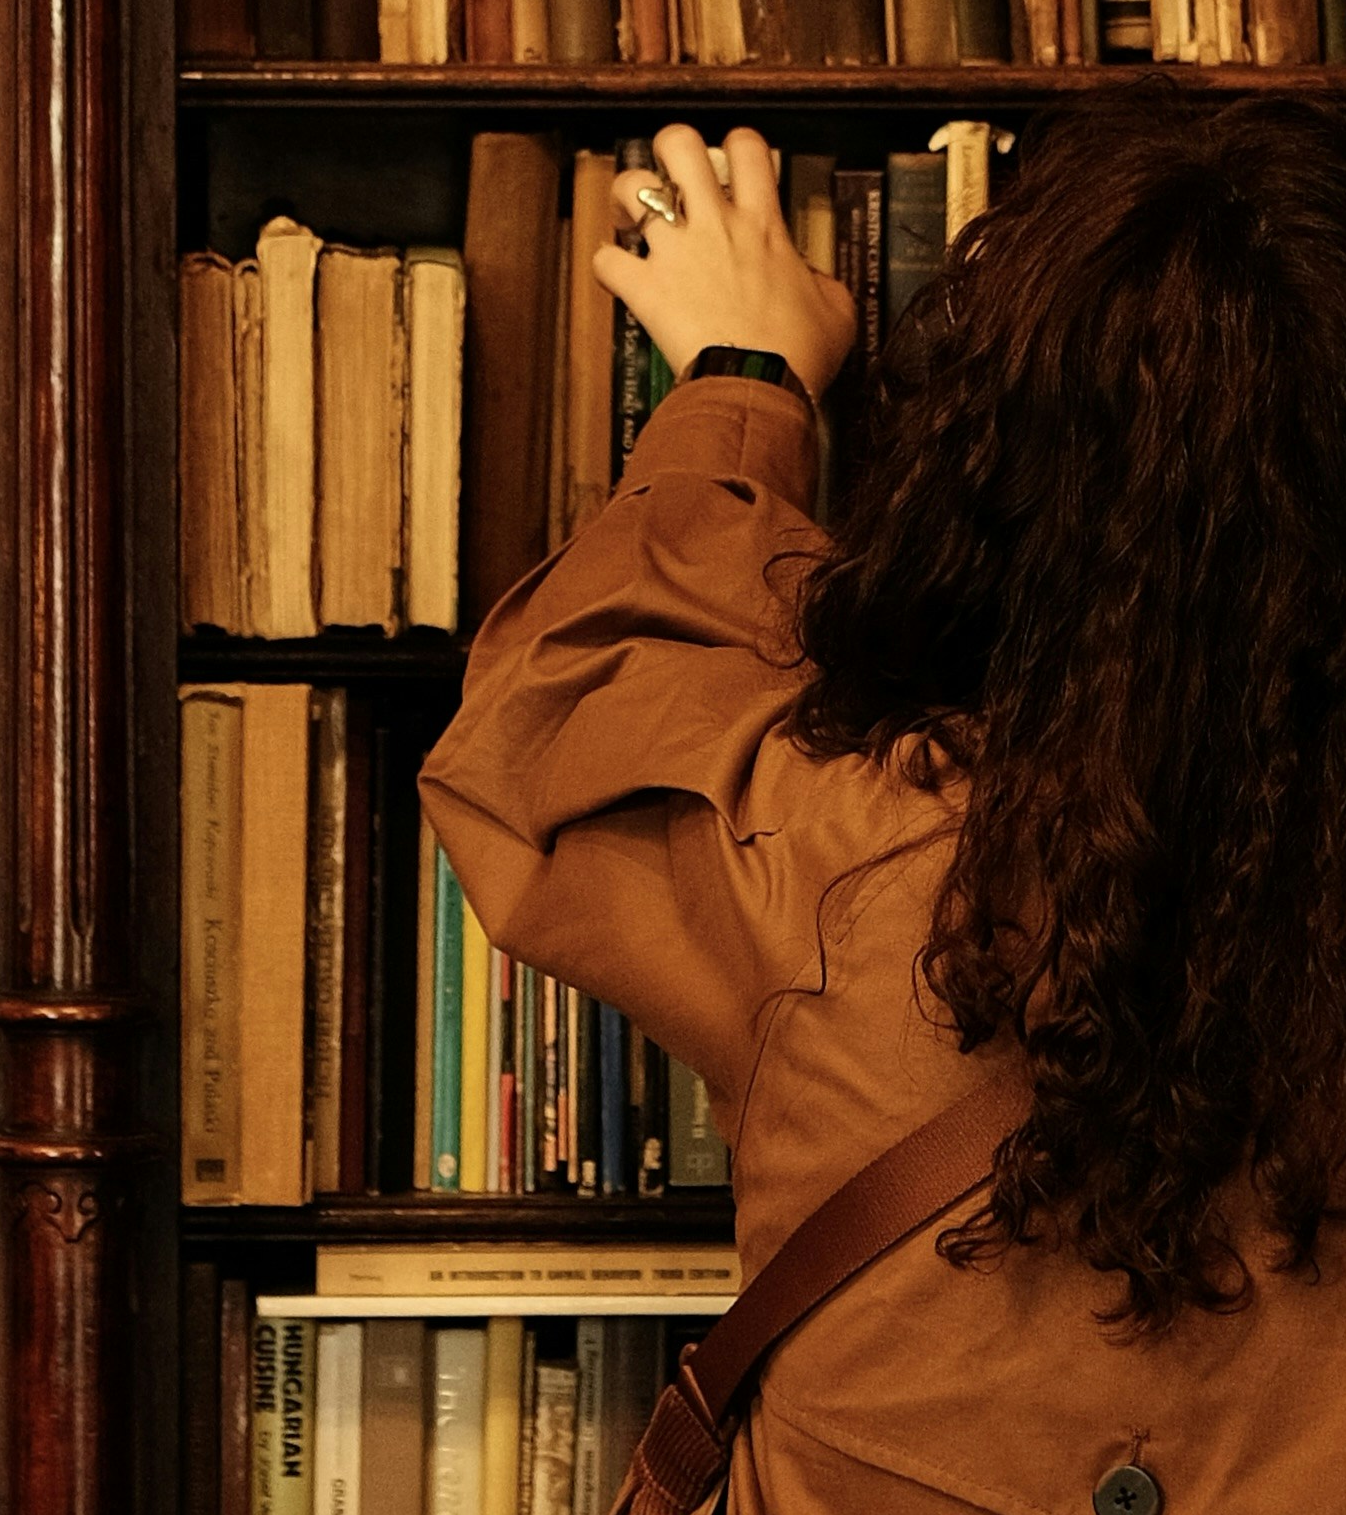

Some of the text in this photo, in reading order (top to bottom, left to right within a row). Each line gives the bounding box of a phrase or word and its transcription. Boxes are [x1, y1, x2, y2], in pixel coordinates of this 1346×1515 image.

[866, 248, 881, 284] CAST
[254, 1325, 277, 1414] CUISINE
[282, 1325, 303, 1478] HUNGARIAN
